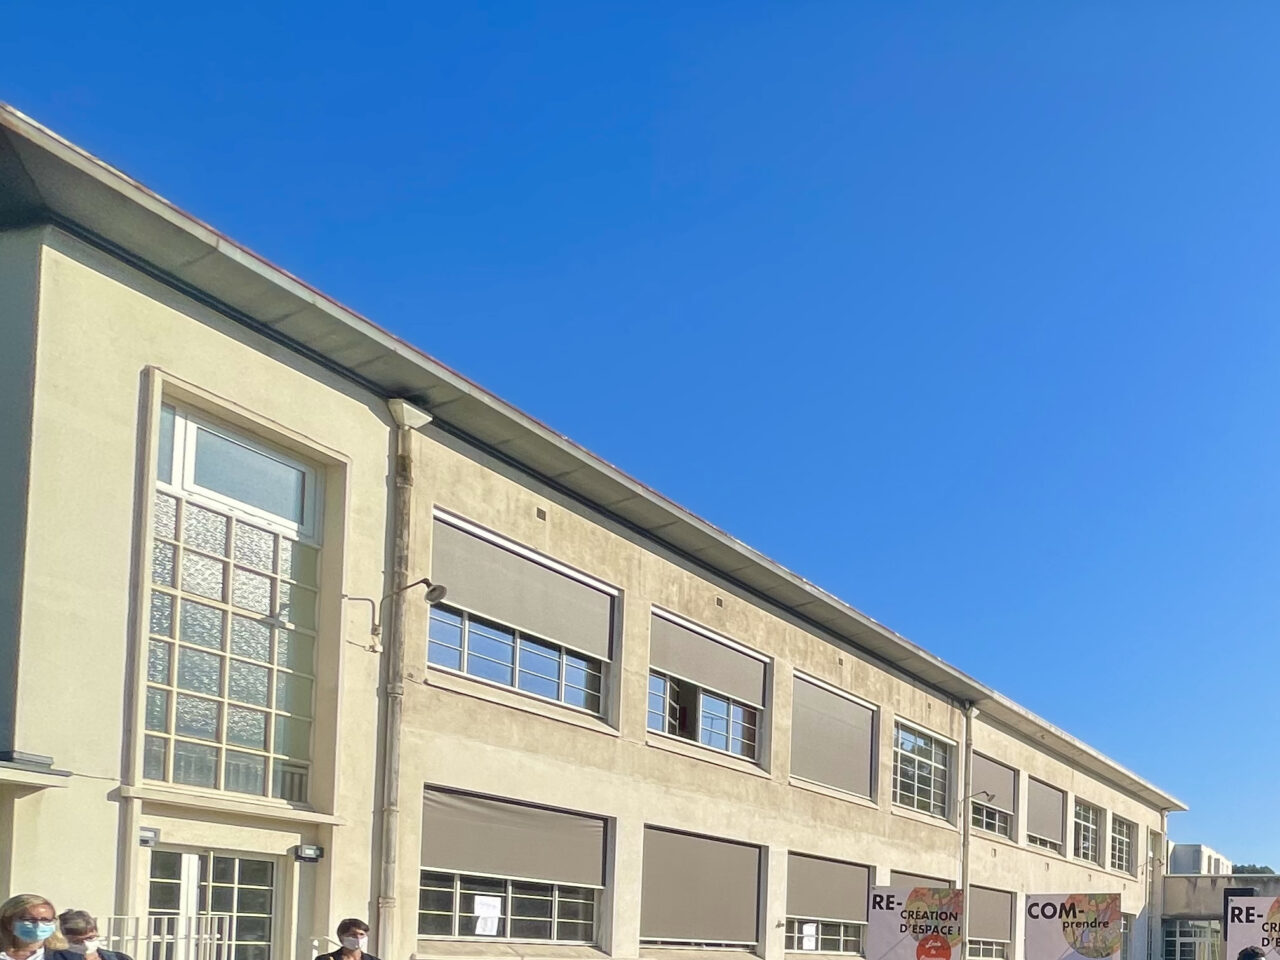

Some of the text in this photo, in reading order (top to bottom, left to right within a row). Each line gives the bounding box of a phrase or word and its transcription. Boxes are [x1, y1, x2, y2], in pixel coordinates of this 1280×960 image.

[872, 894, 903, 910] RE-
[900, 907, 958, 921] CRÉATION
[1027, 902, 1084, 920] COM-
[1230, 906, 1264, 924] RE-
[900, 924, 954, 936] D'ESPACE
[1062, 917, 1110, 932] prendre
